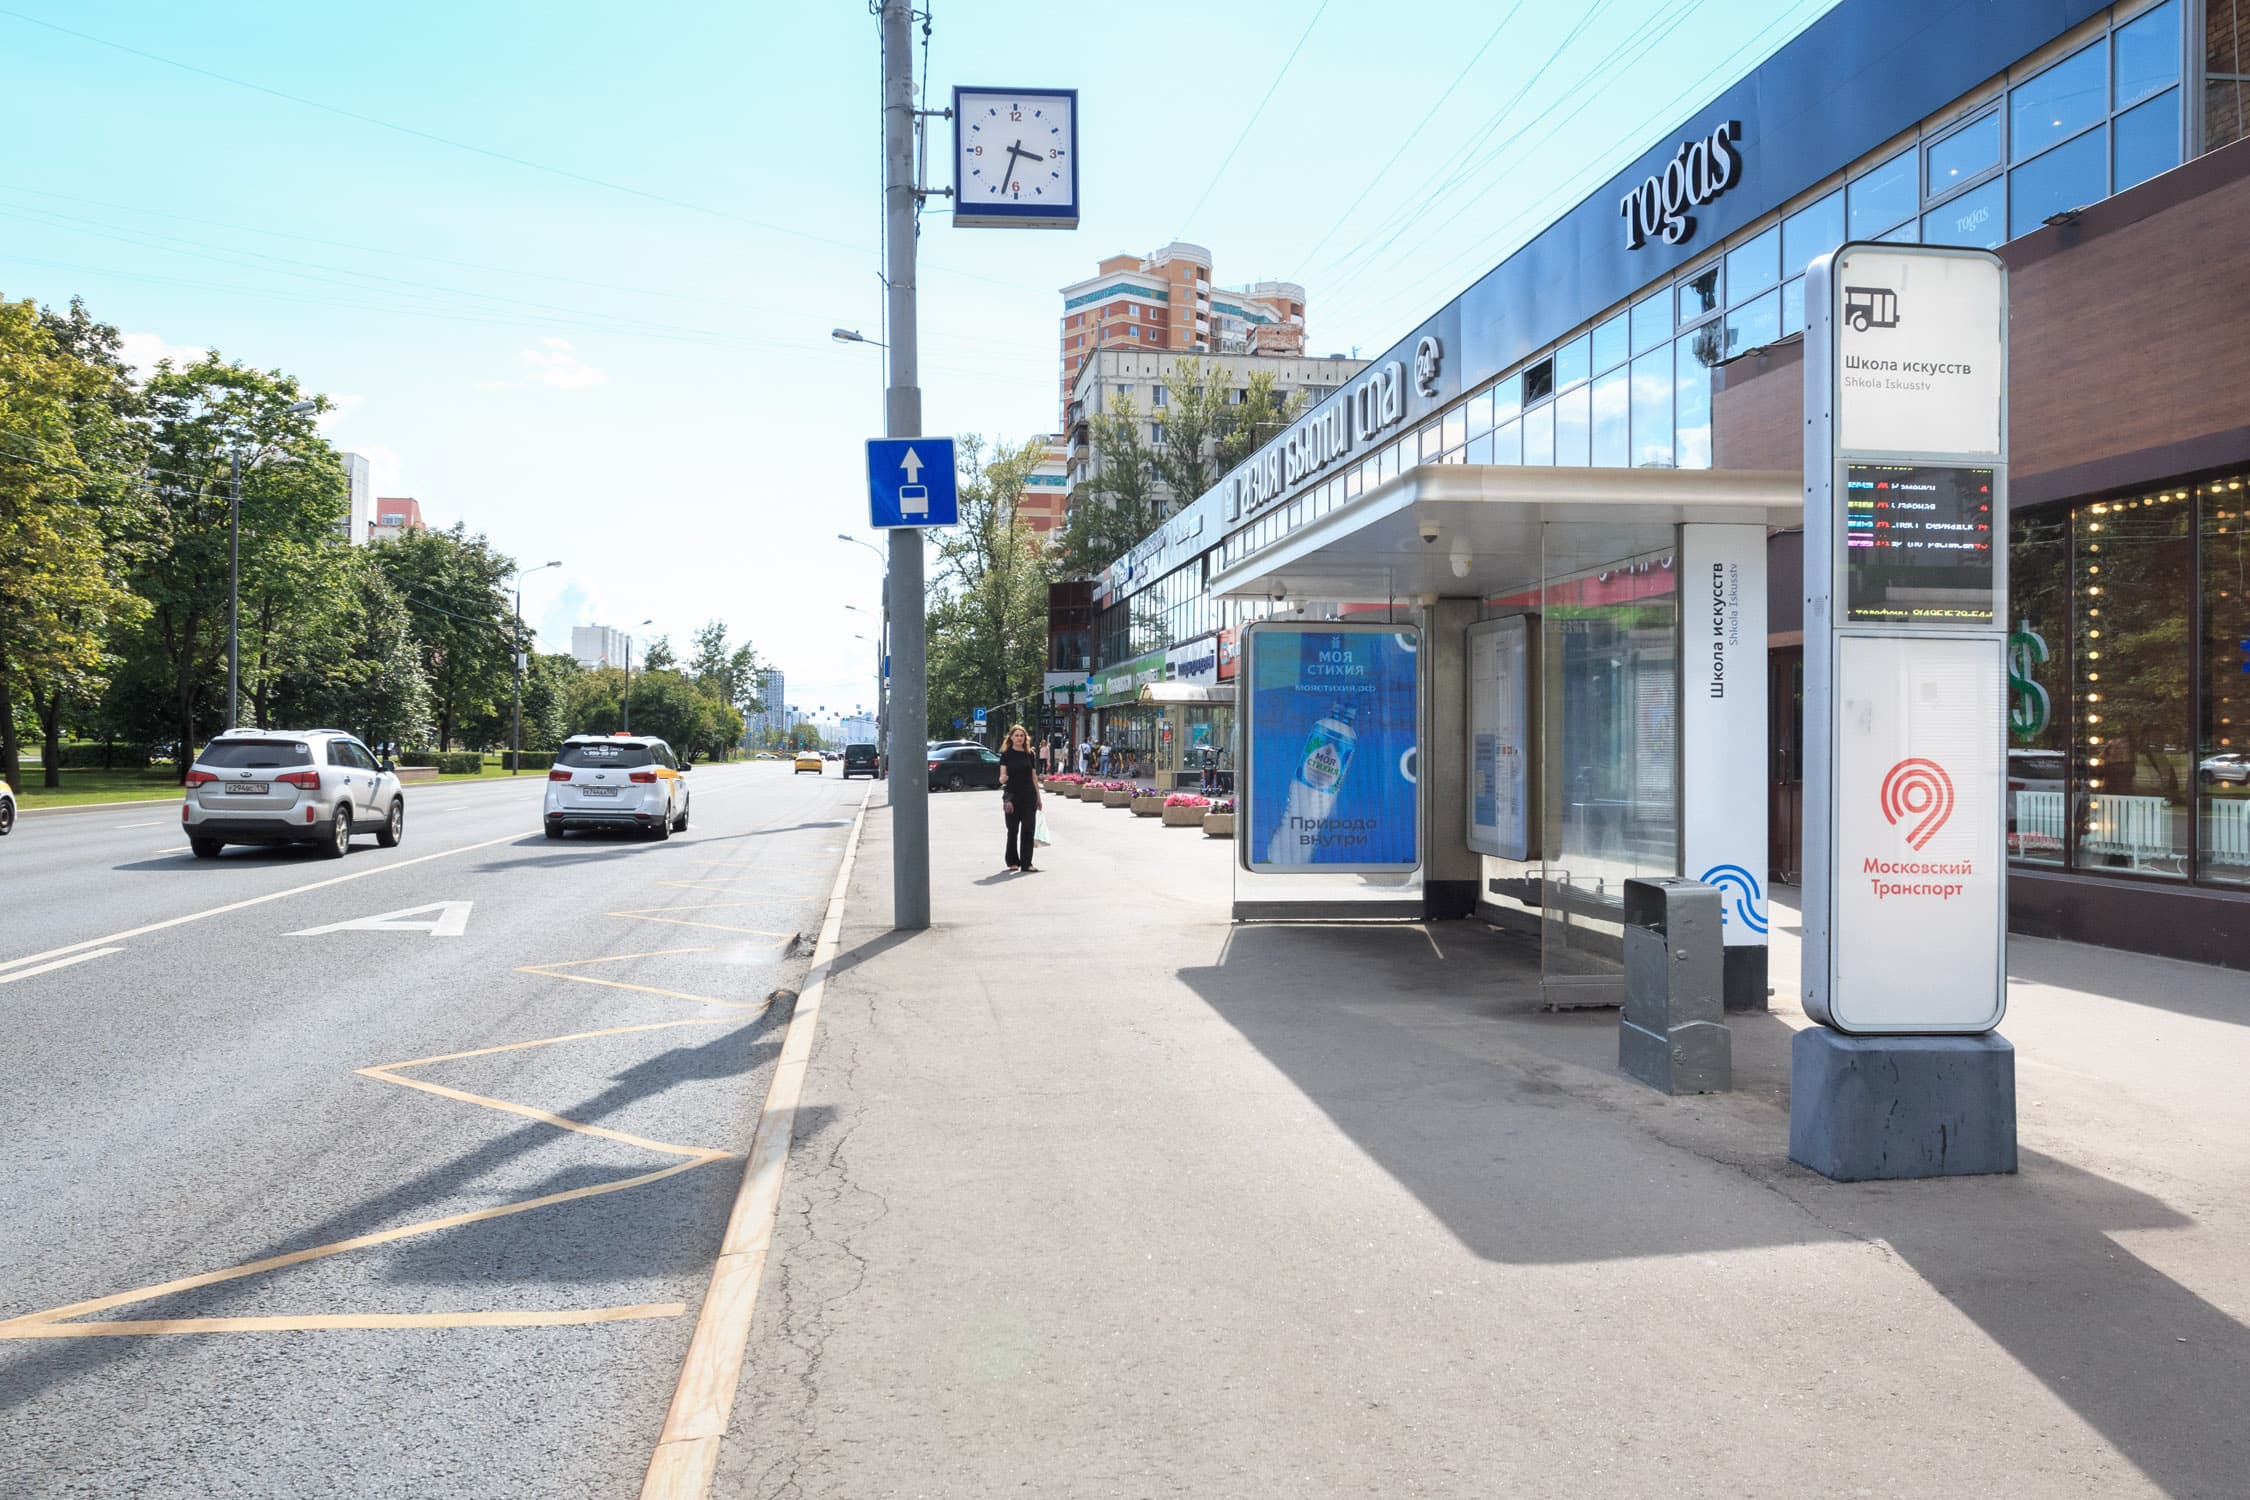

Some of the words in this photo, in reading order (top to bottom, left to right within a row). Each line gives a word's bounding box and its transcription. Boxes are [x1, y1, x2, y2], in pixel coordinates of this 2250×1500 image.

[1010, 111, 1022, 122] 12
[975, 145, 983, 156] 9
[1049, 149, 1057, 159] 3
[1011, 181, 1020, 192] 6
[1845, 355, 1898, 371] Школа
[1902, 362, 1972, 377] искусств
[1844, 376, 1883, 389] Shkola
[1885, 379, 1932, 391] Iskusstv
[1730, 563, 1739, 607] Iskusstv
[1713, 562, 1726, 636] искусств
[1728, 610, 1739, 646] Shkola
[1319, 651, 1353, 663] МОЯ
[1307, 664, 1364, 676] СТИХИЯ
[1710, 642, 1724, 699] Школа
[1290, 815, 1377, 833] Природа
[1299, 833, 1368, 848] внутри
[1863, 856, 1972, 876] Московский
[1871, 878, 1963, 900] Транспорт
